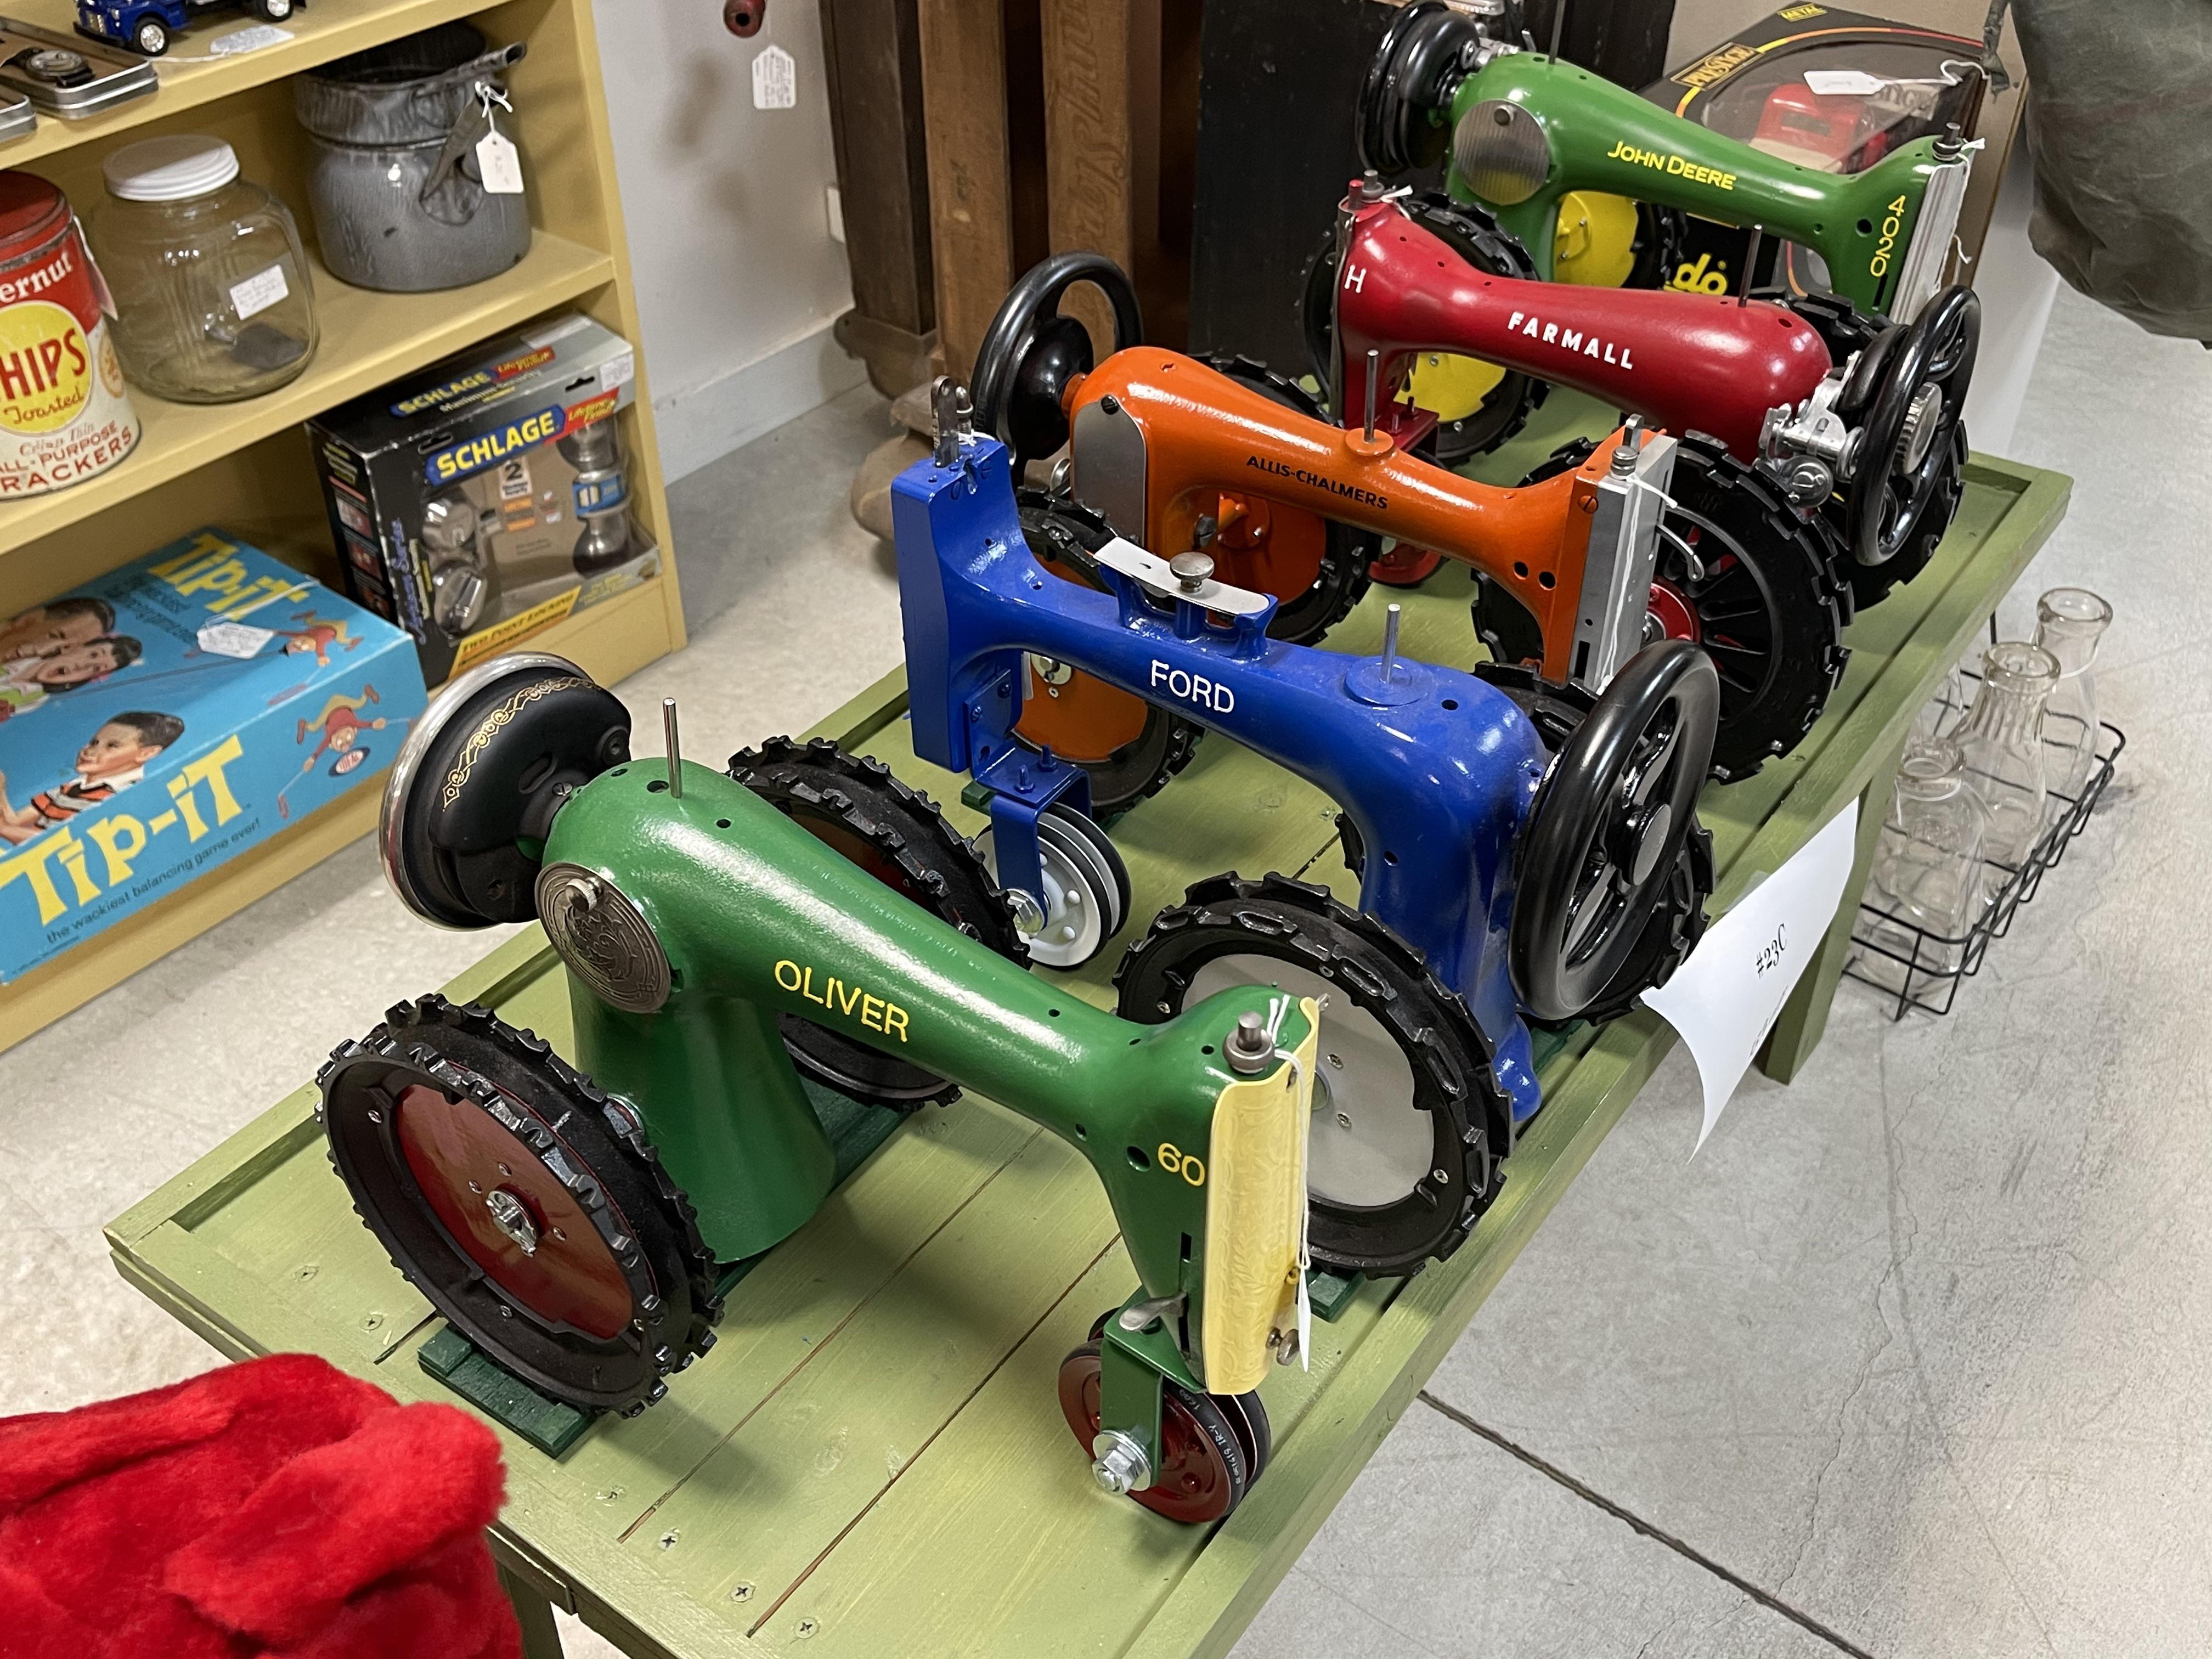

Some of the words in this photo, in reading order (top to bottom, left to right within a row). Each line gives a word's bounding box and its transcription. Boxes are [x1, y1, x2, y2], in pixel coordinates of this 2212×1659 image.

[1607, 141, 1664, 171] JOHN
[1667, 156, 1737, 190] DEERE
[1869, 195, 1905, 277] 4020
[1344, 265, 1367, 294] H
[0, 328, 86, 401] HIPS
[1507, 312, 1633, 370] FARMALL
[4, 385, 85, 425] Toasted
[398, 371, 492, 414] SCHLAGE
[0, 420, 117, 473] LL-PURPOSE
[437, 410, 556, 479] SCHLAGE
[504, 462, 522, 481] 2
[1246, 456, 1388, 509] ALLIS-CHALMERS
[1151, 659, 1234, 713] FORD
[47, 927, 70, 944] the
[131, 859, 194, 898] balancing
[194, 838, 229, 866] game
[231, 817, 260, 843] ever!
[1756, 923, 1788, 979] #23C
[775, 960, 909, 1042] OLIVER
[1158, 1142, 1206, 1186] 60
